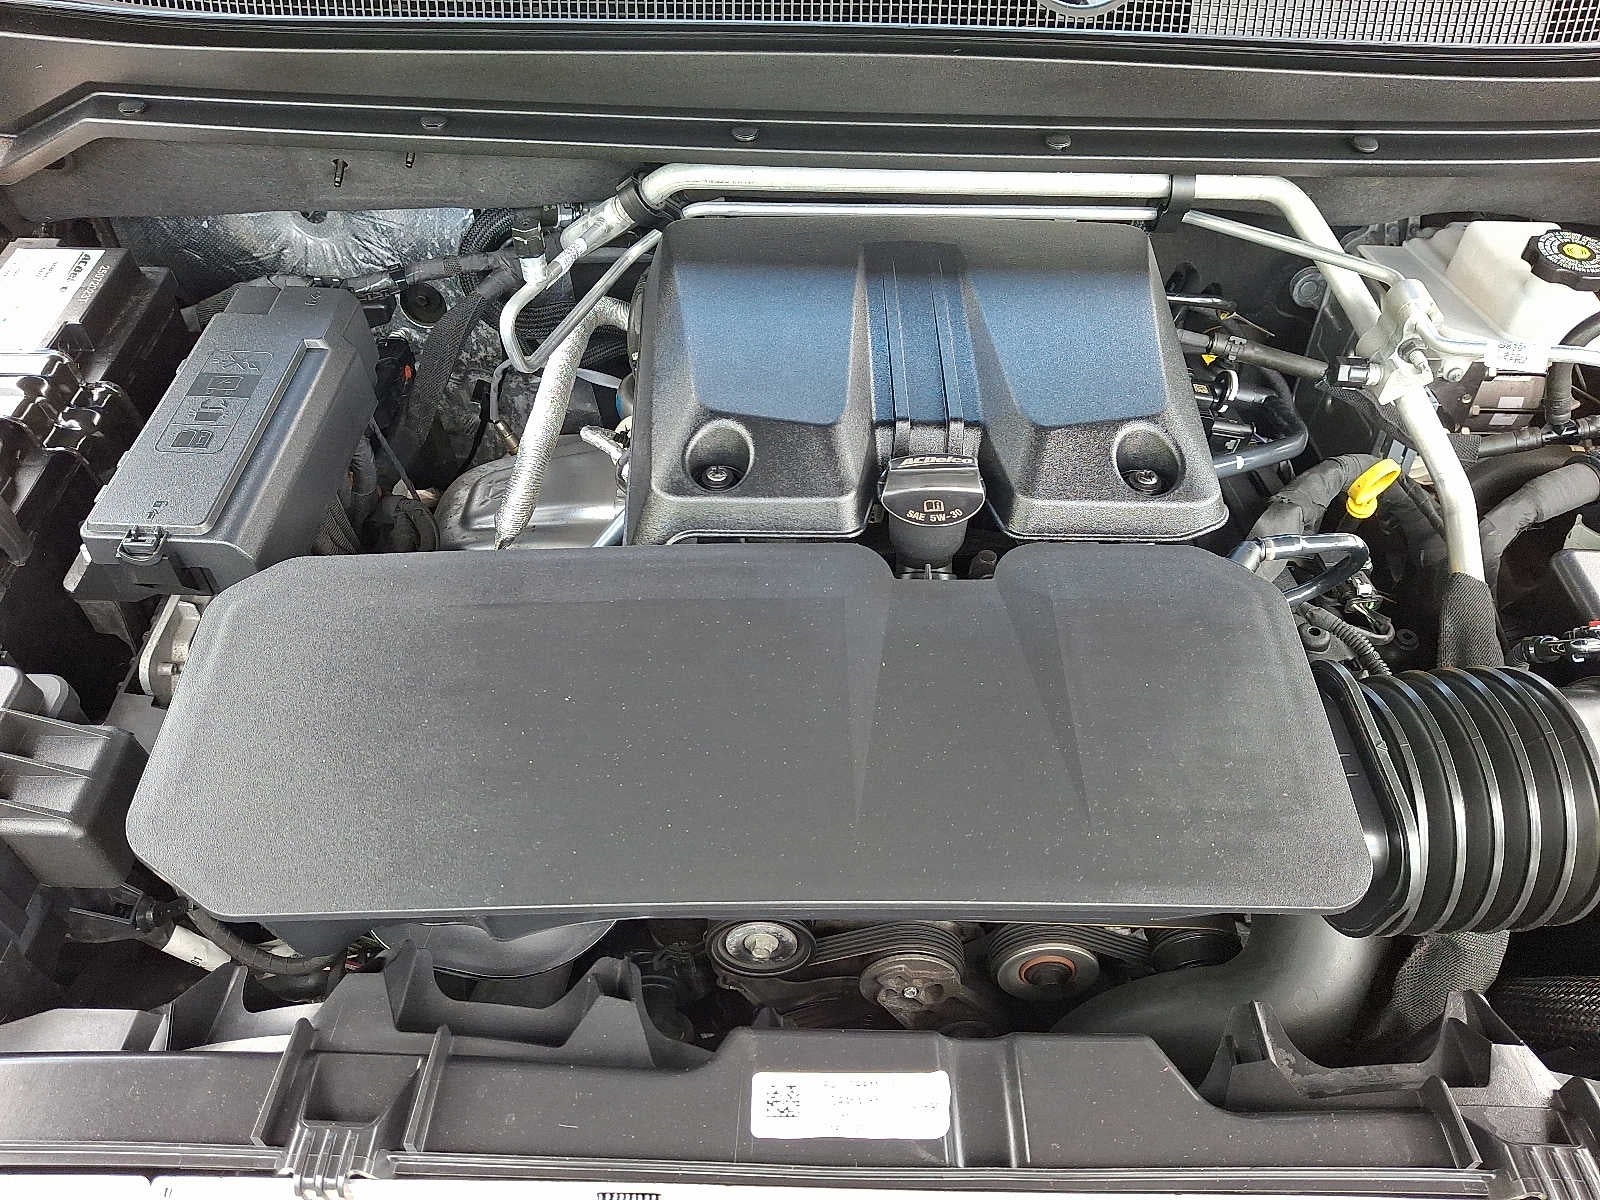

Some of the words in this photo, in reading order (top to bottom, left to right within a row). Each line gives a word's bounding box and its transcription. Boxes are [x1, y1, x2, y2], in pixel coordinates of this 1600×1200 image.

[899, 456, 973, 466] ACDelco
[906, 509, 926, 521] SAE
[929, 508, 963, 522] 5W-30
